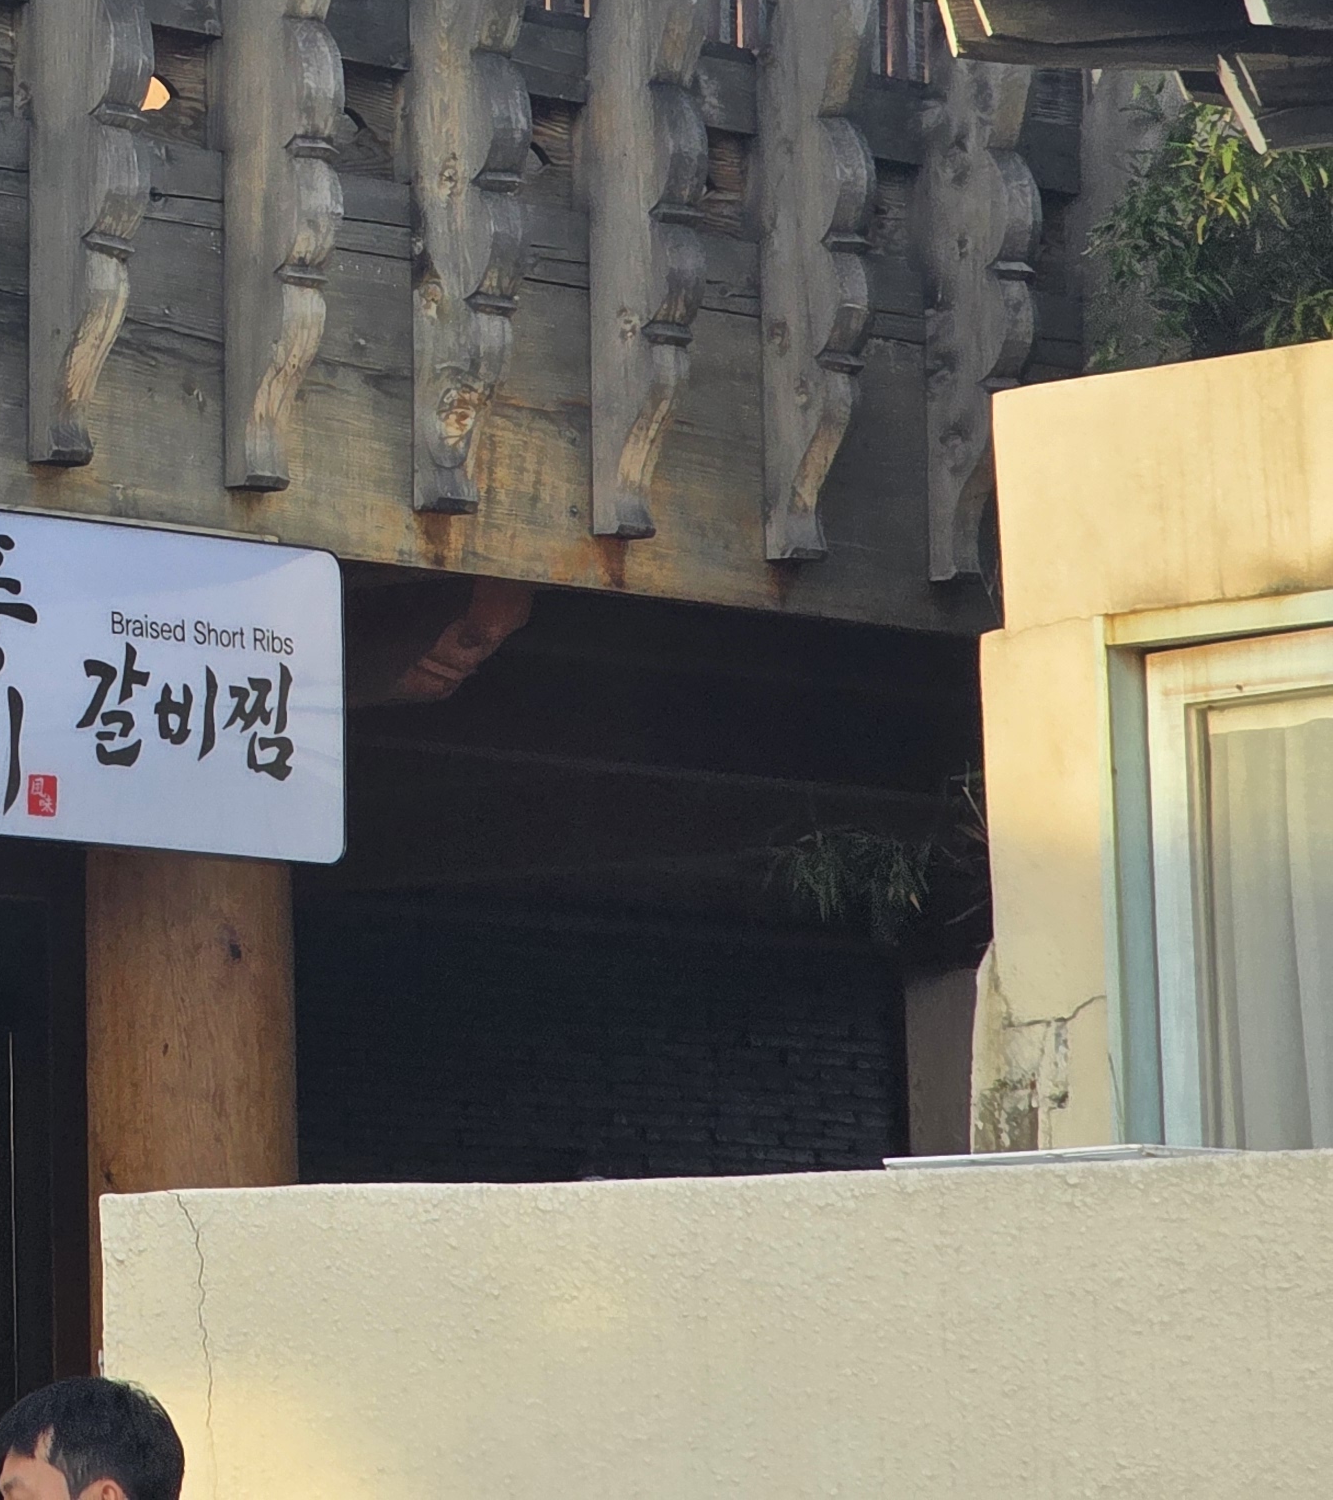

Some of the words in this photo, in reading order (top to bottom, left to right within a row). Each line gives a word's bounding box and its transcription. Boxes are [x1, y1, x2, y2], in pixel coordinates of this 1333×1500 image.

[110, 610, 186, 644] Braised
[194, 621, 246, 650] Short
[253, 627, 295, 656] Ribs
[75, 641, 295, 782] 갈비찜
